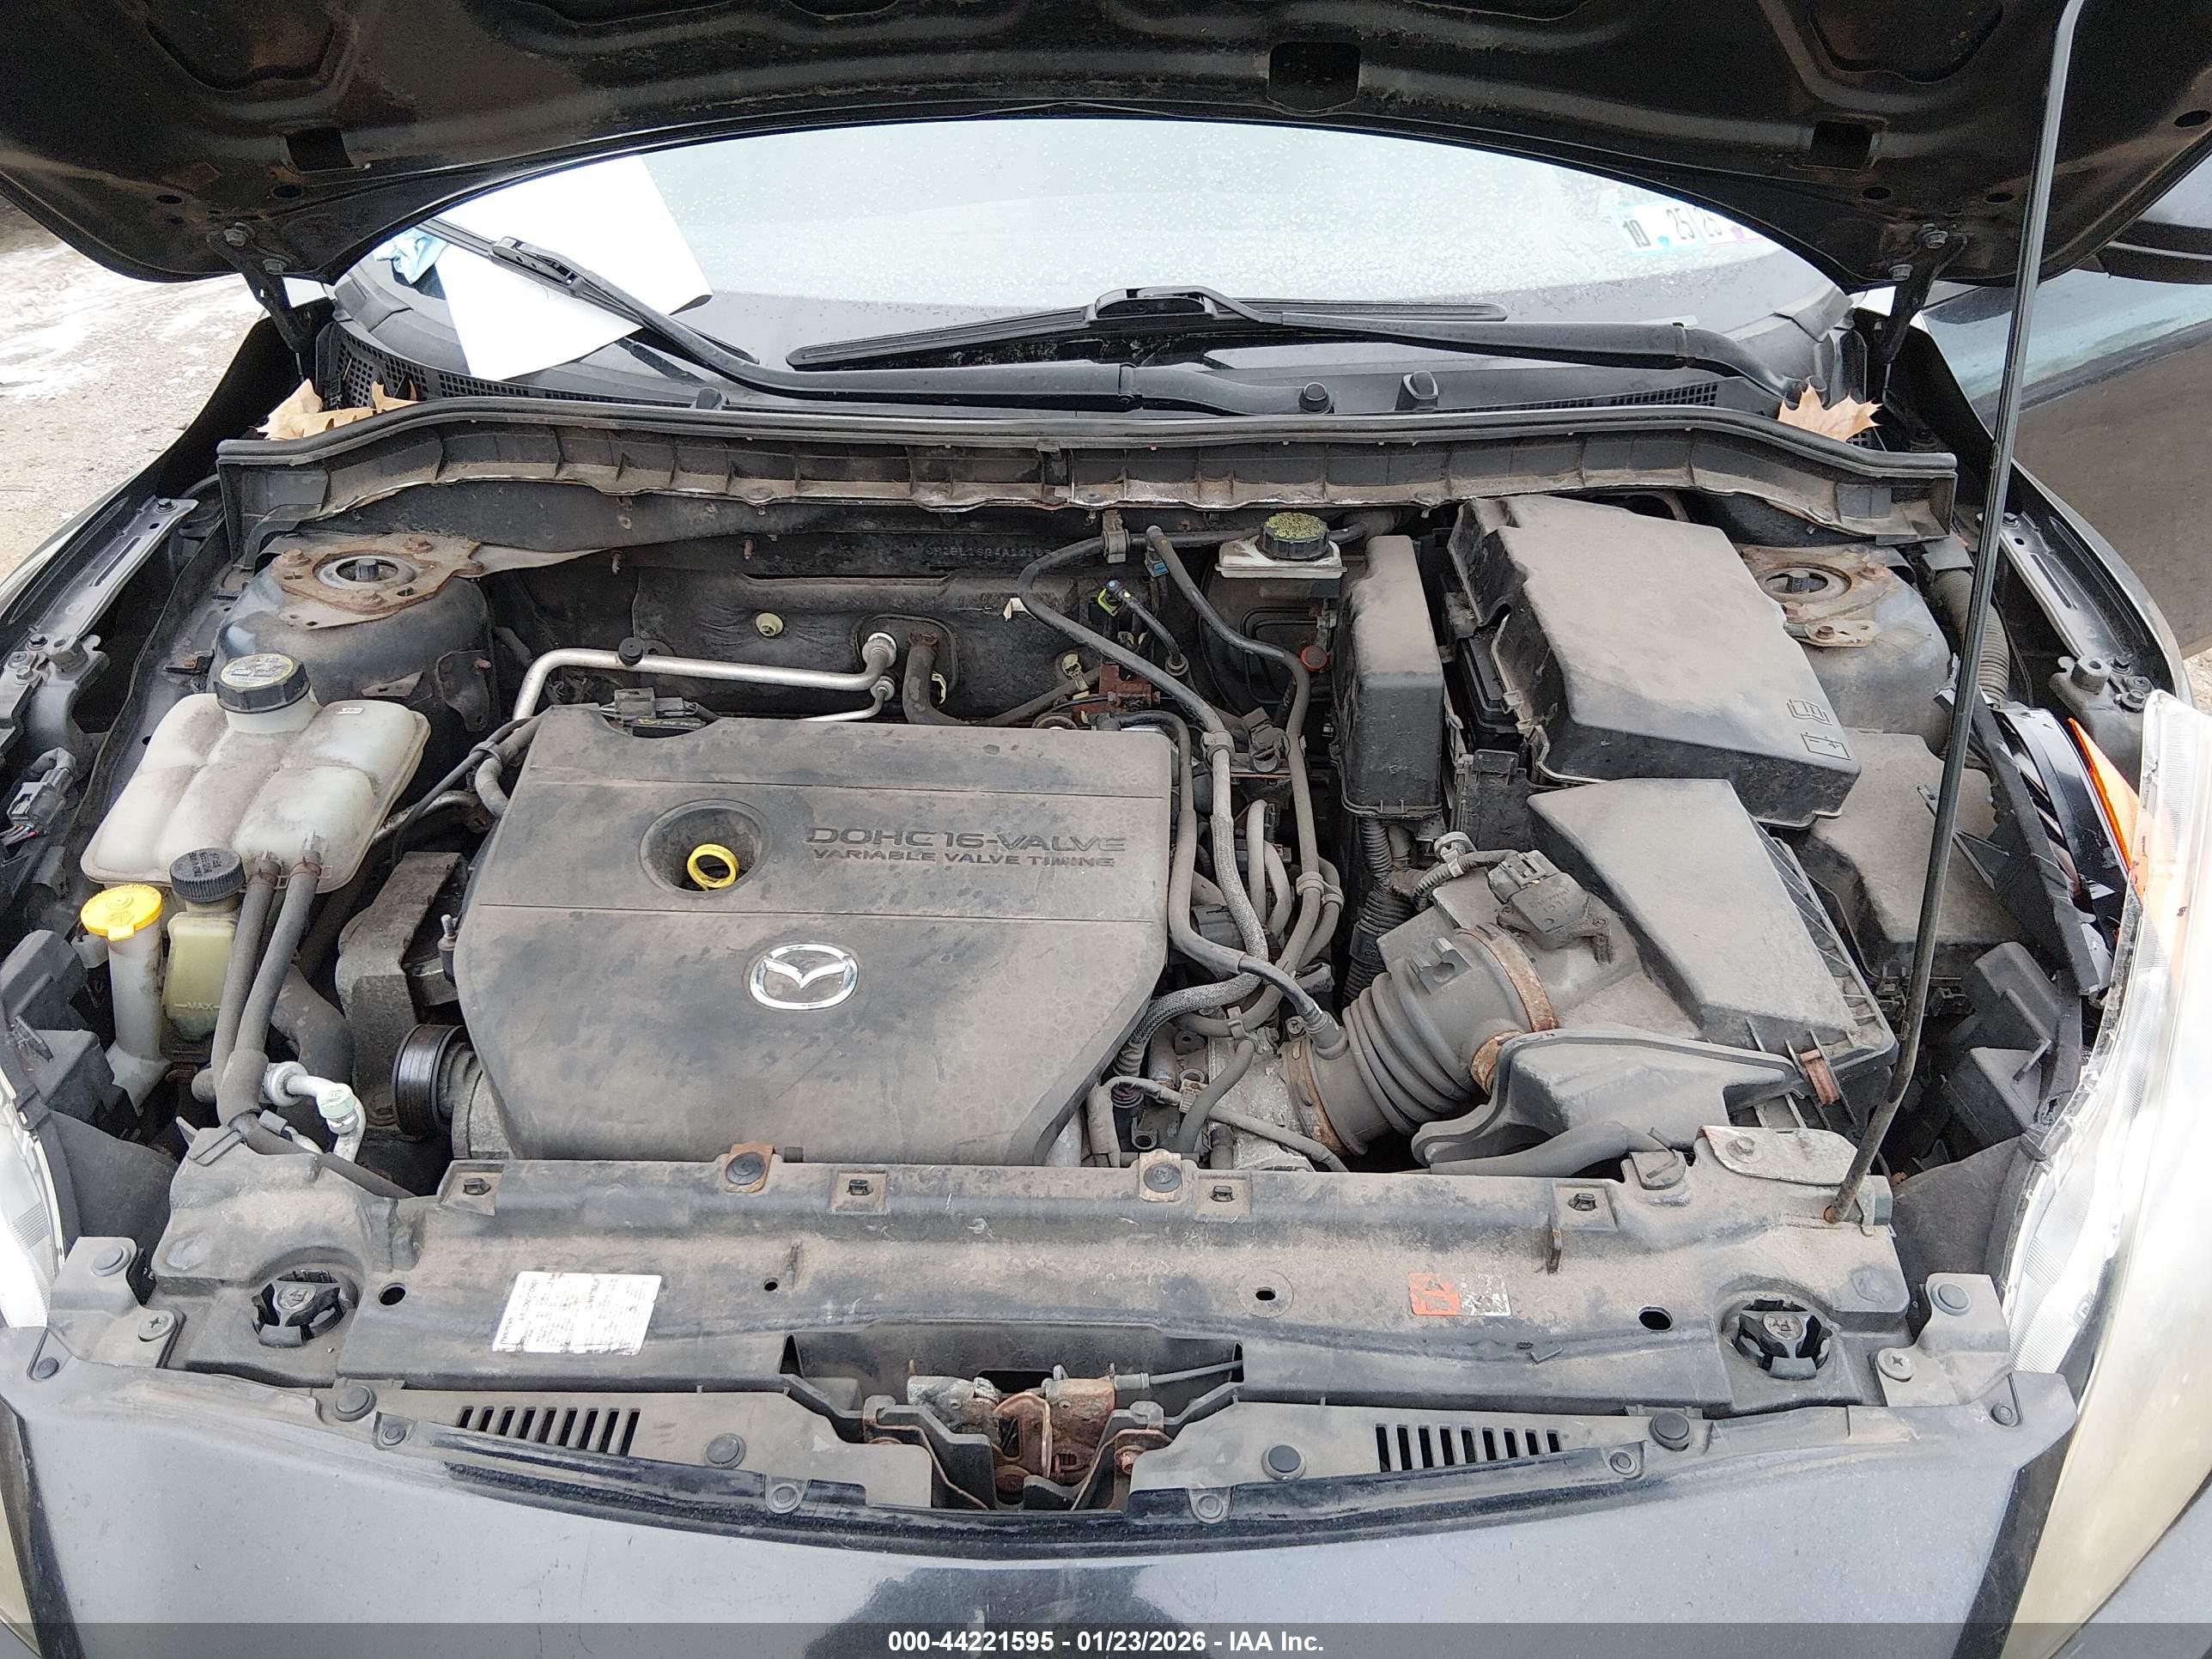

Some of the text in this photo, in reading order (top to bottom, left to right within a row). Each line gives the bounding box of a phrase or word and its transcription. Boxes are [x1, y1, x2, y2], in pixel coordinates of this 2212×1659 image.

[1622, 219, 1651, 248] 10
[806, 828, 1127, 853] DOHC 16-VALVE
[813, 848, 936, 862] VARIABLE
[945, 852, 1020, 866] VALVE
[186, 1002, 214, 1011] MAX
